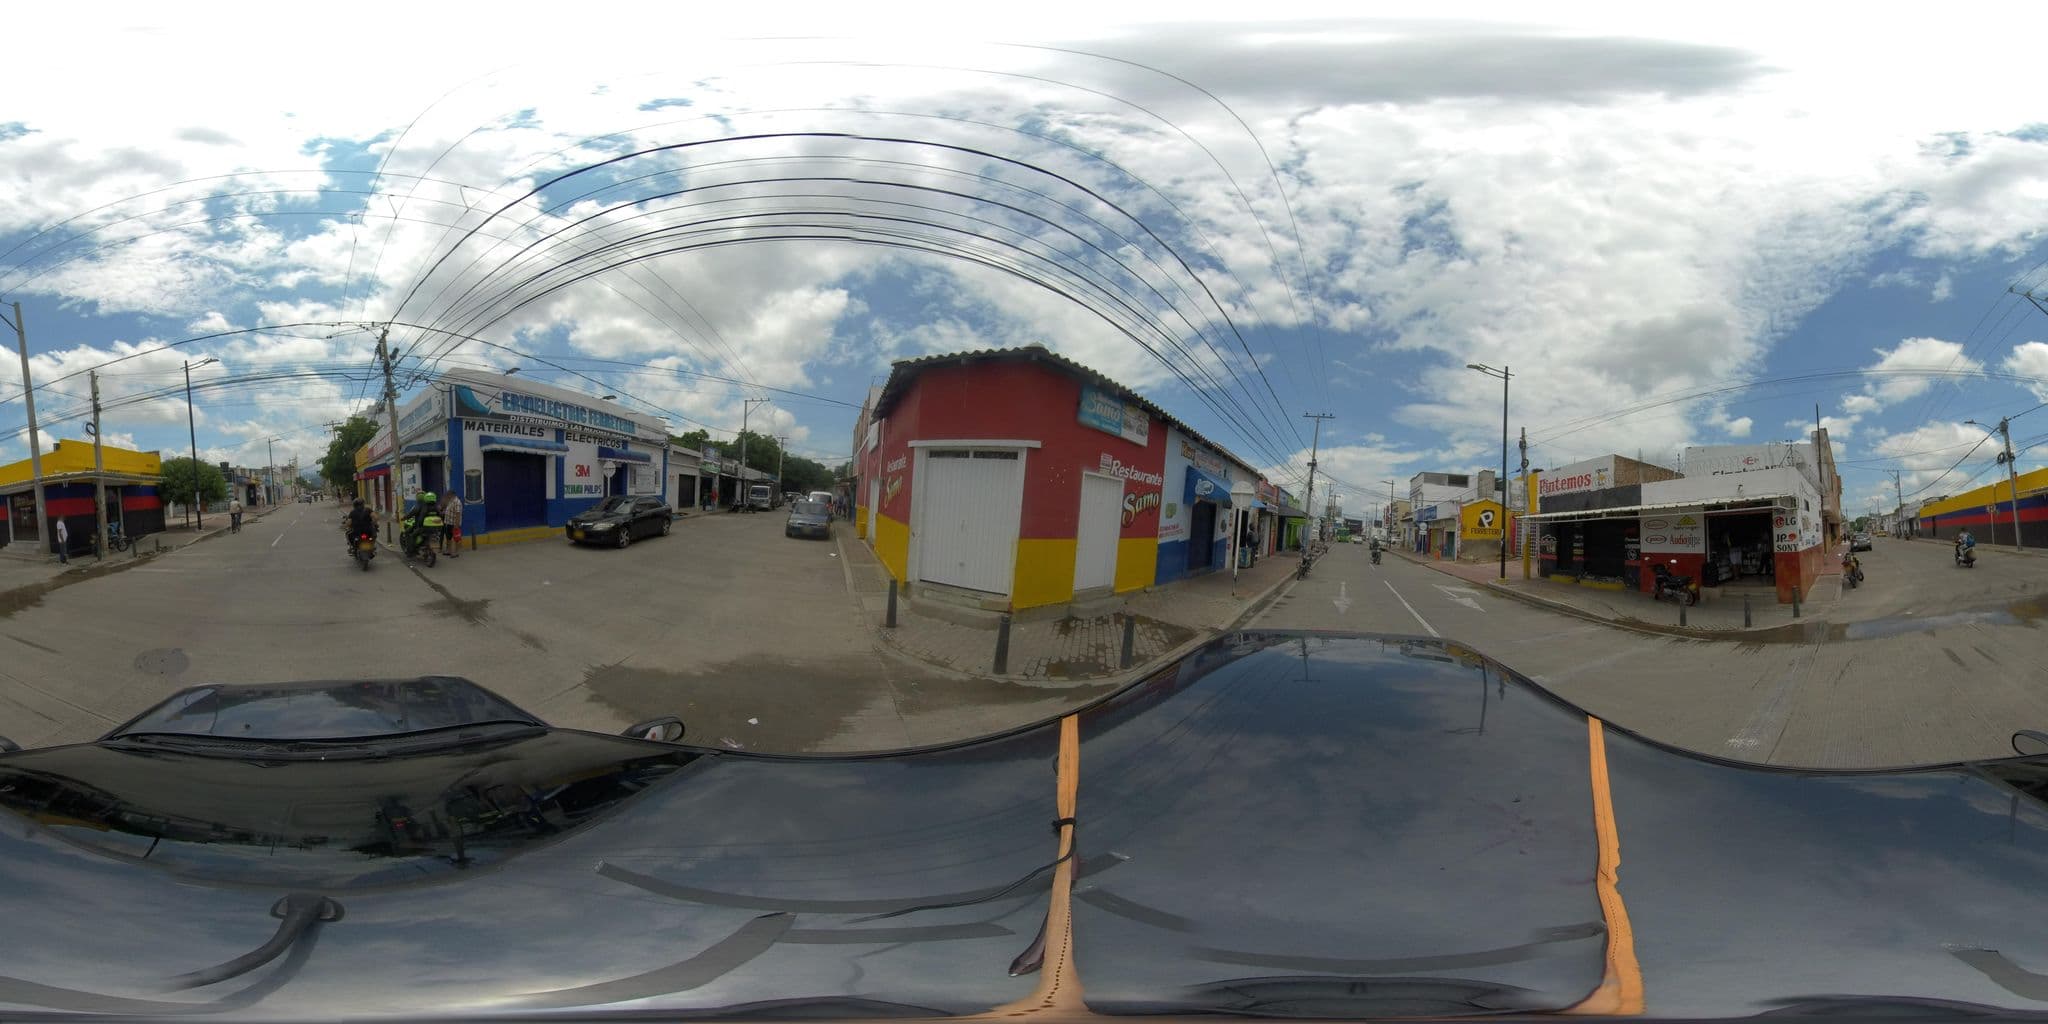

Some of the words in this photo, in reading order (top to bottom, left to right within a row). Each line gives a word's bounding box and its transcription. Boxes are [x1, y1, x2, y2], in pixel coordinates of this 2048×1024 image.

[464, 420, 545, 438] MATERIALES
[510, 414, 568, 430] DISTRIBUIMOS
[565, 431, 622, 449] ELECTRICOS
[575, 464, 591, 478] 3M
[1110, 459, 1163, 487] Restaurante
[1538, 473, 1592, 495] Pintemos
[1121, 491, 1160, 528] Samo
[1785, 516, 1797, 526] LG
[1471, 528, 1502, 536] FERRETERI
[1776, 543, 1799, 552] SONY
